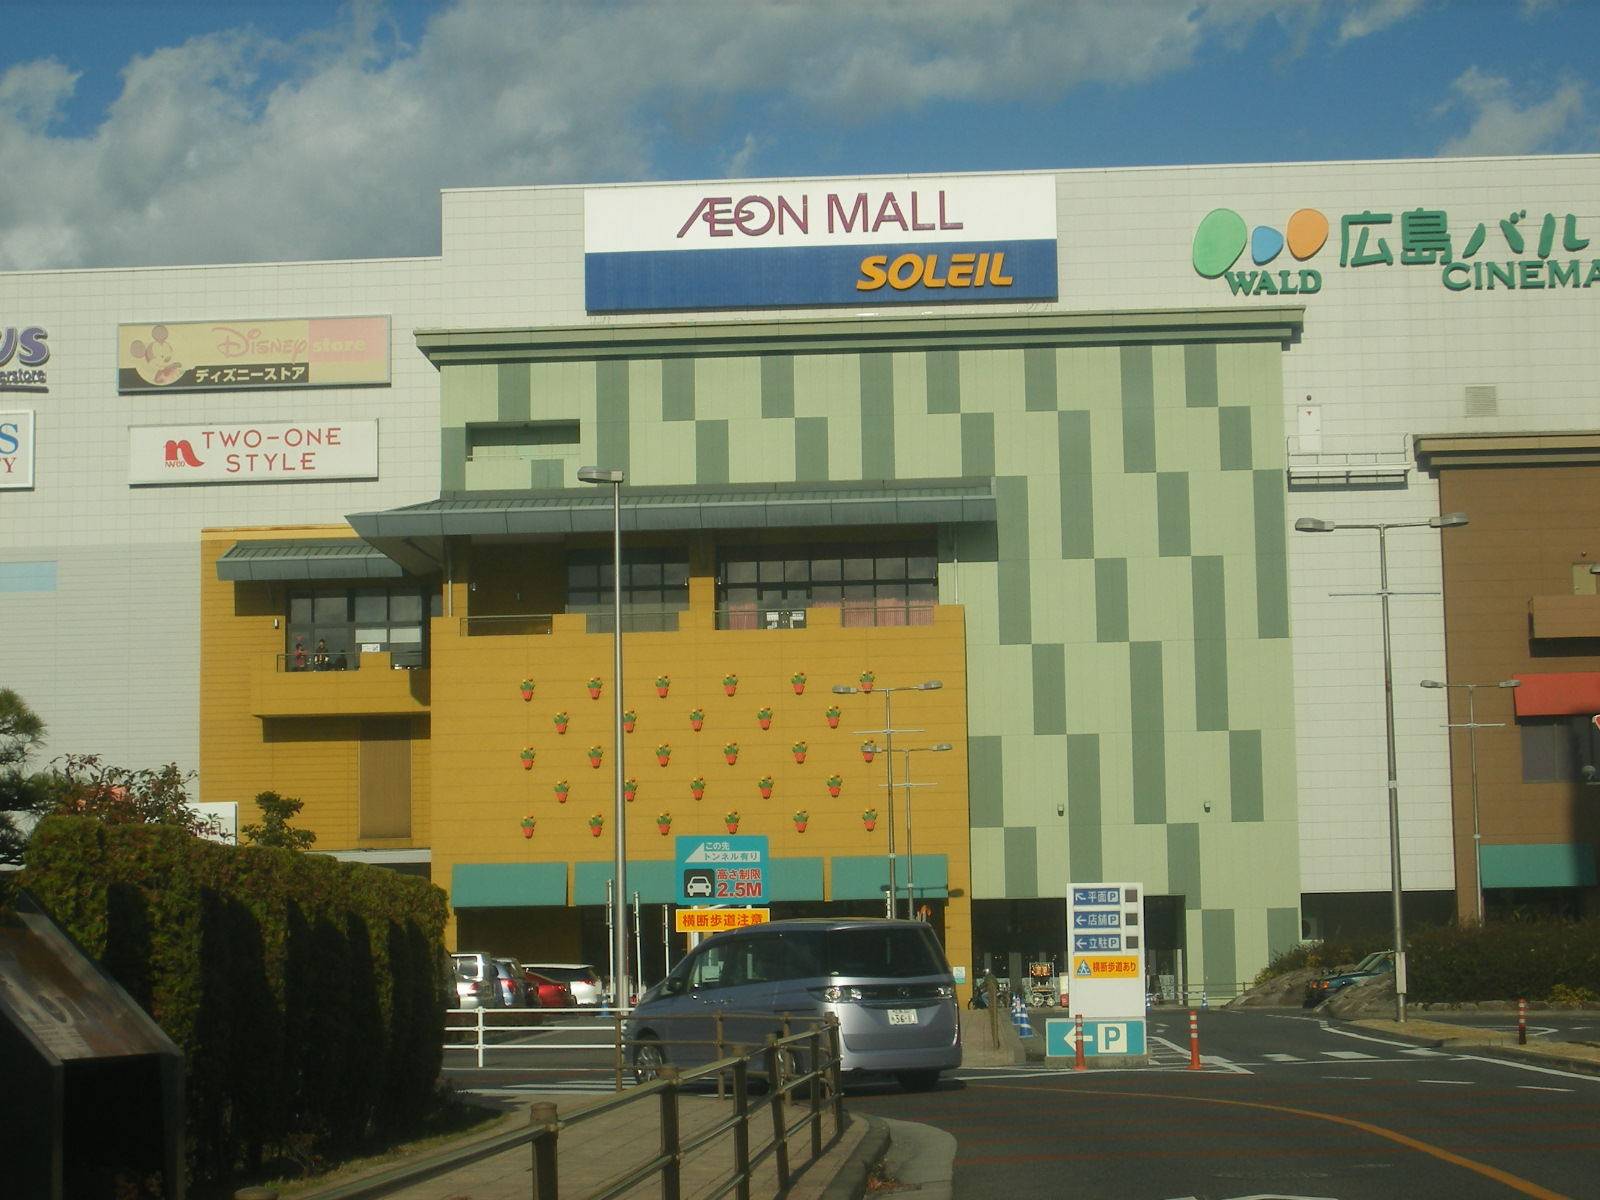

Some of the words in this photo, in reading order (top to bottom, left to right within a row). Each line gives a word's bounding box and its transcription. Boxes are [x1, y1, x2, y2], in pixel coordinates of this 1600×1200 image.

[826, 190, 963, 233] MALL
[1340, 208, 1590, 268] 広島バル
[857, 253, 1013, 291] SOLEIL
[1442, 260, 1600, 291] CINEMA
[1225, 270, 1322, 296] WALD
[312, 338, 366, 352] store
[195, 366, 306, 383] ディズニーストア
[201, 427, 342, 449] TWO-ONE
[0, 457, 16, 473] Y
[226, 452, 316, 473] STYLE
[705, 842, 730, 850] この先
[704, 852, 757, 861] トンネル有り
[717, 869, 761, 880] 高さ制限
[717, 882, 762, 897] 2.5M
[1092, 962, 1136, 973] 横断歩道あり
[1105, 1027, 1120, 1050] P
